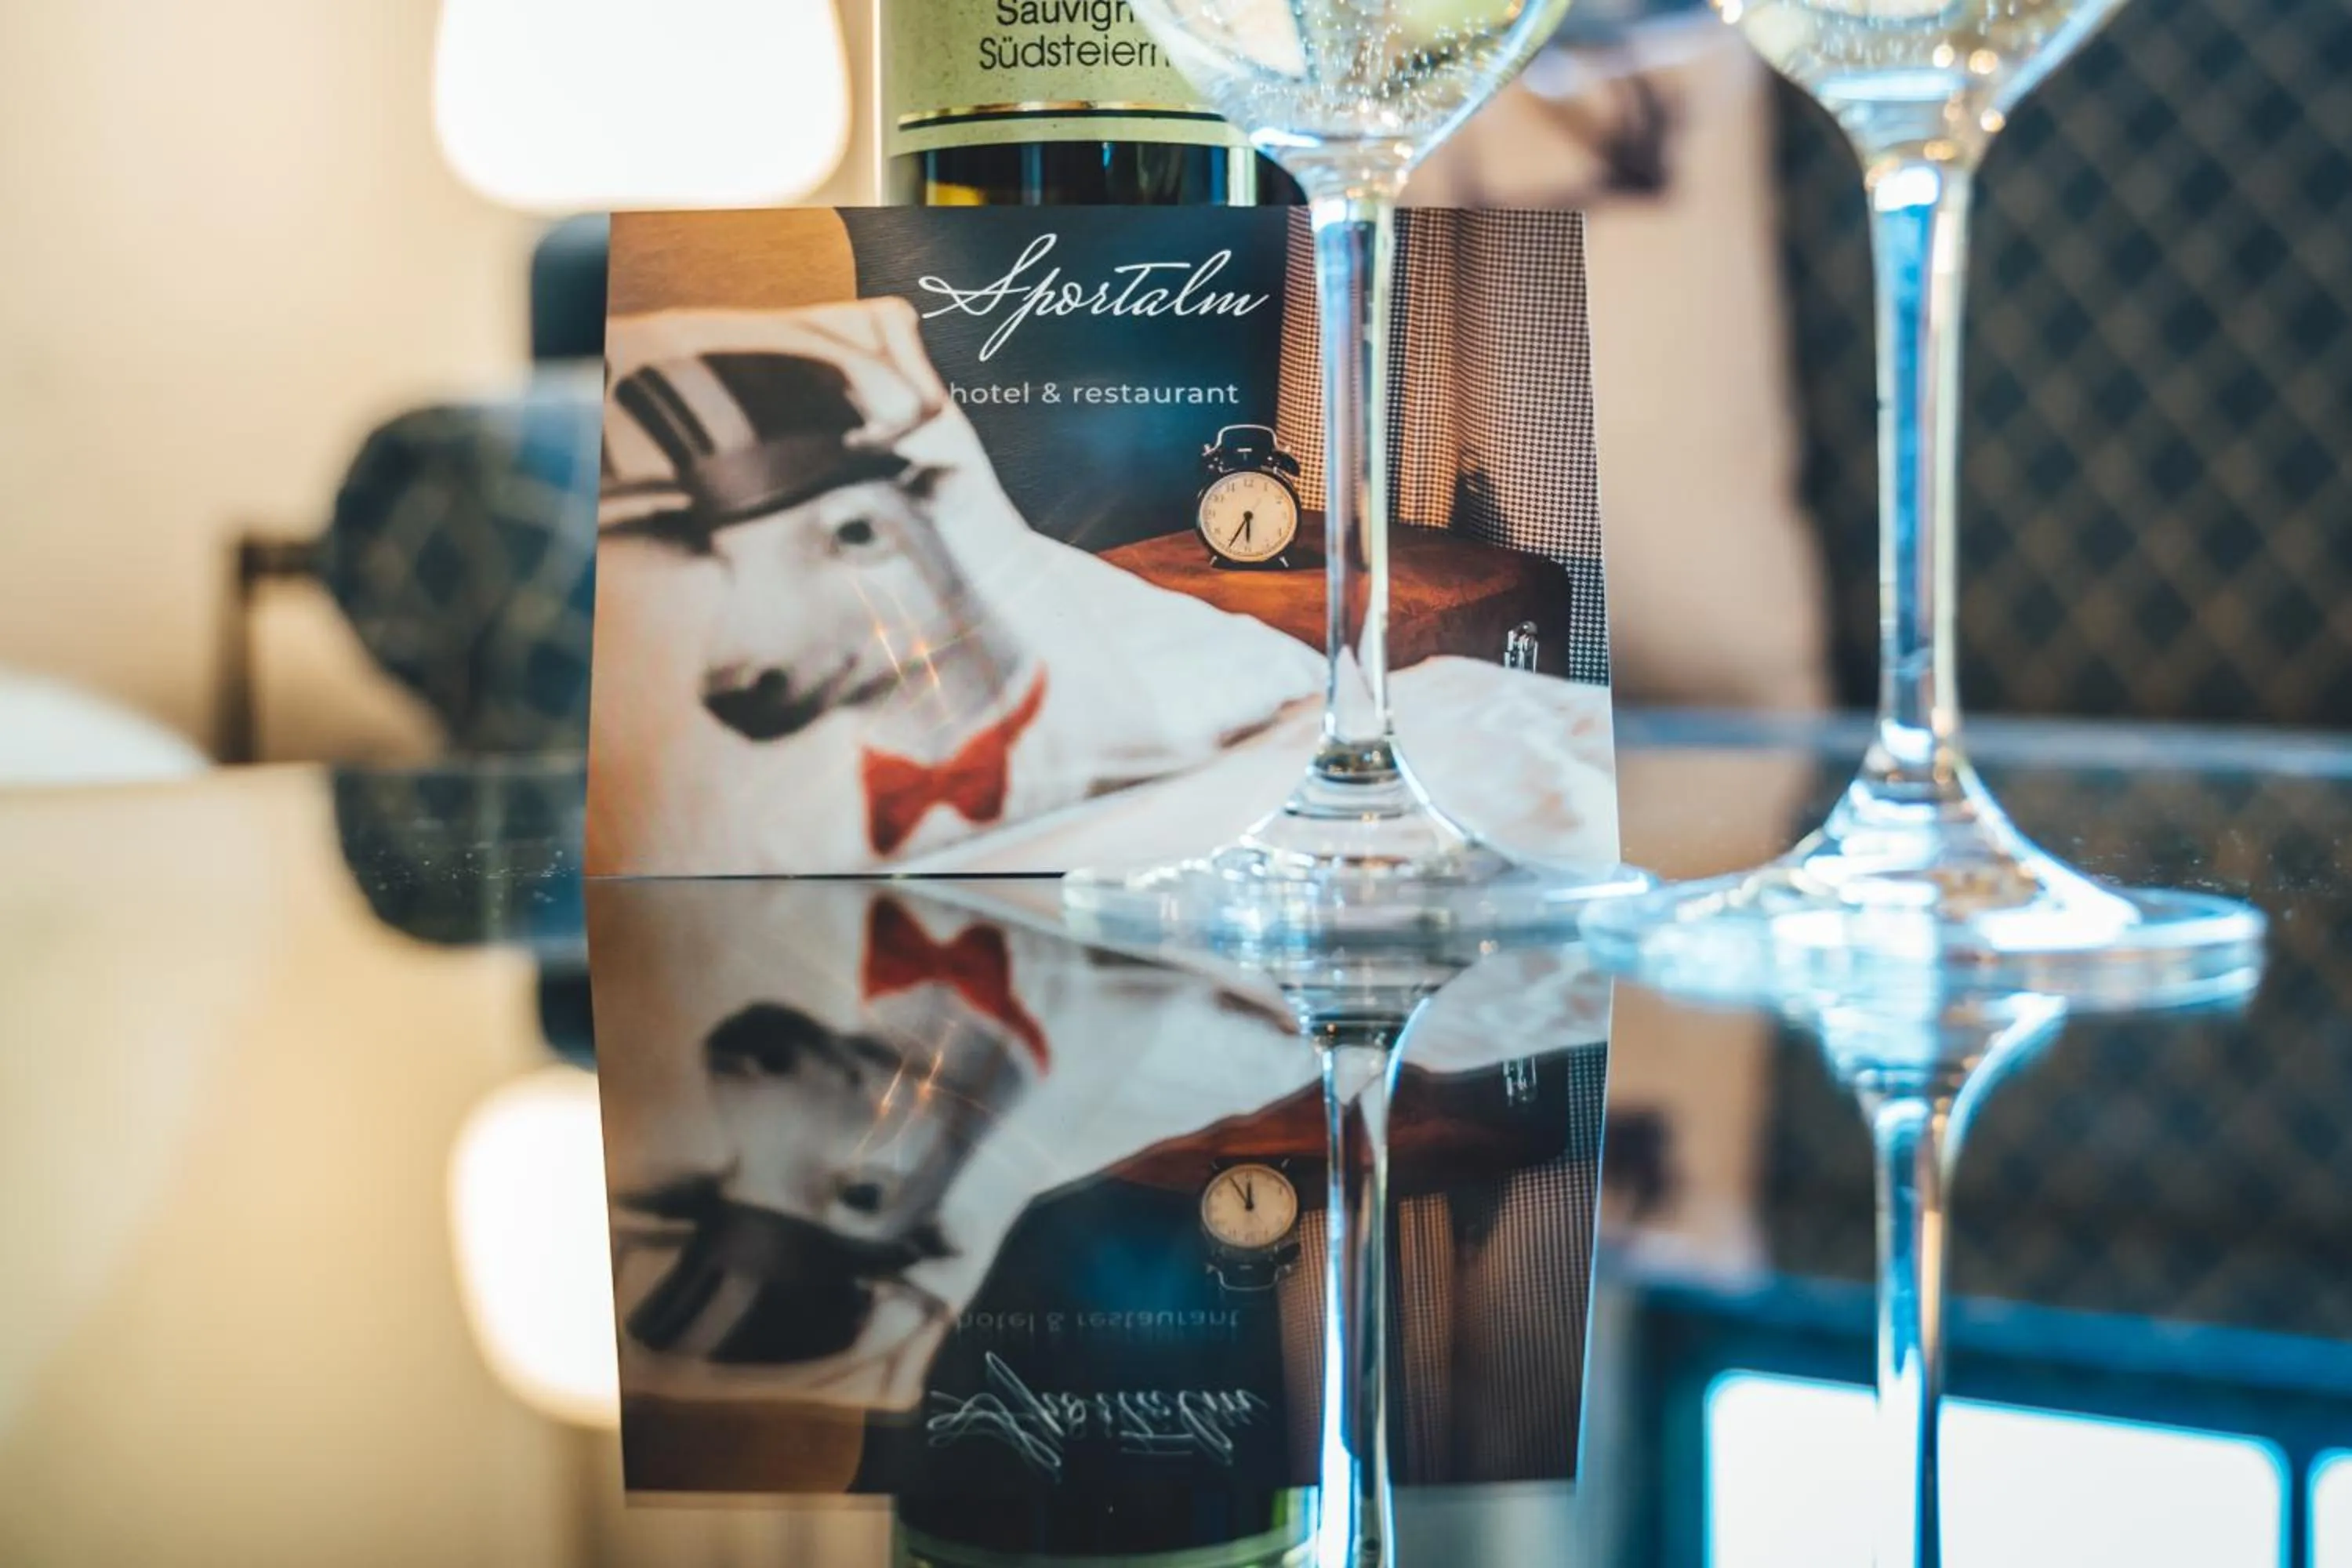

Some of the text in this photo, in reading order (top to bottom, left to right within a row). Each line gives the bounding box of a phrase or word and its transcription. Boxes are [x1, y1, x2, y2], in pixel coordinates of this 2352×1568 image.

[918, 233, 1269, 361] Sportalm
[950, 383, 1239, 404] hotel & restaurant
